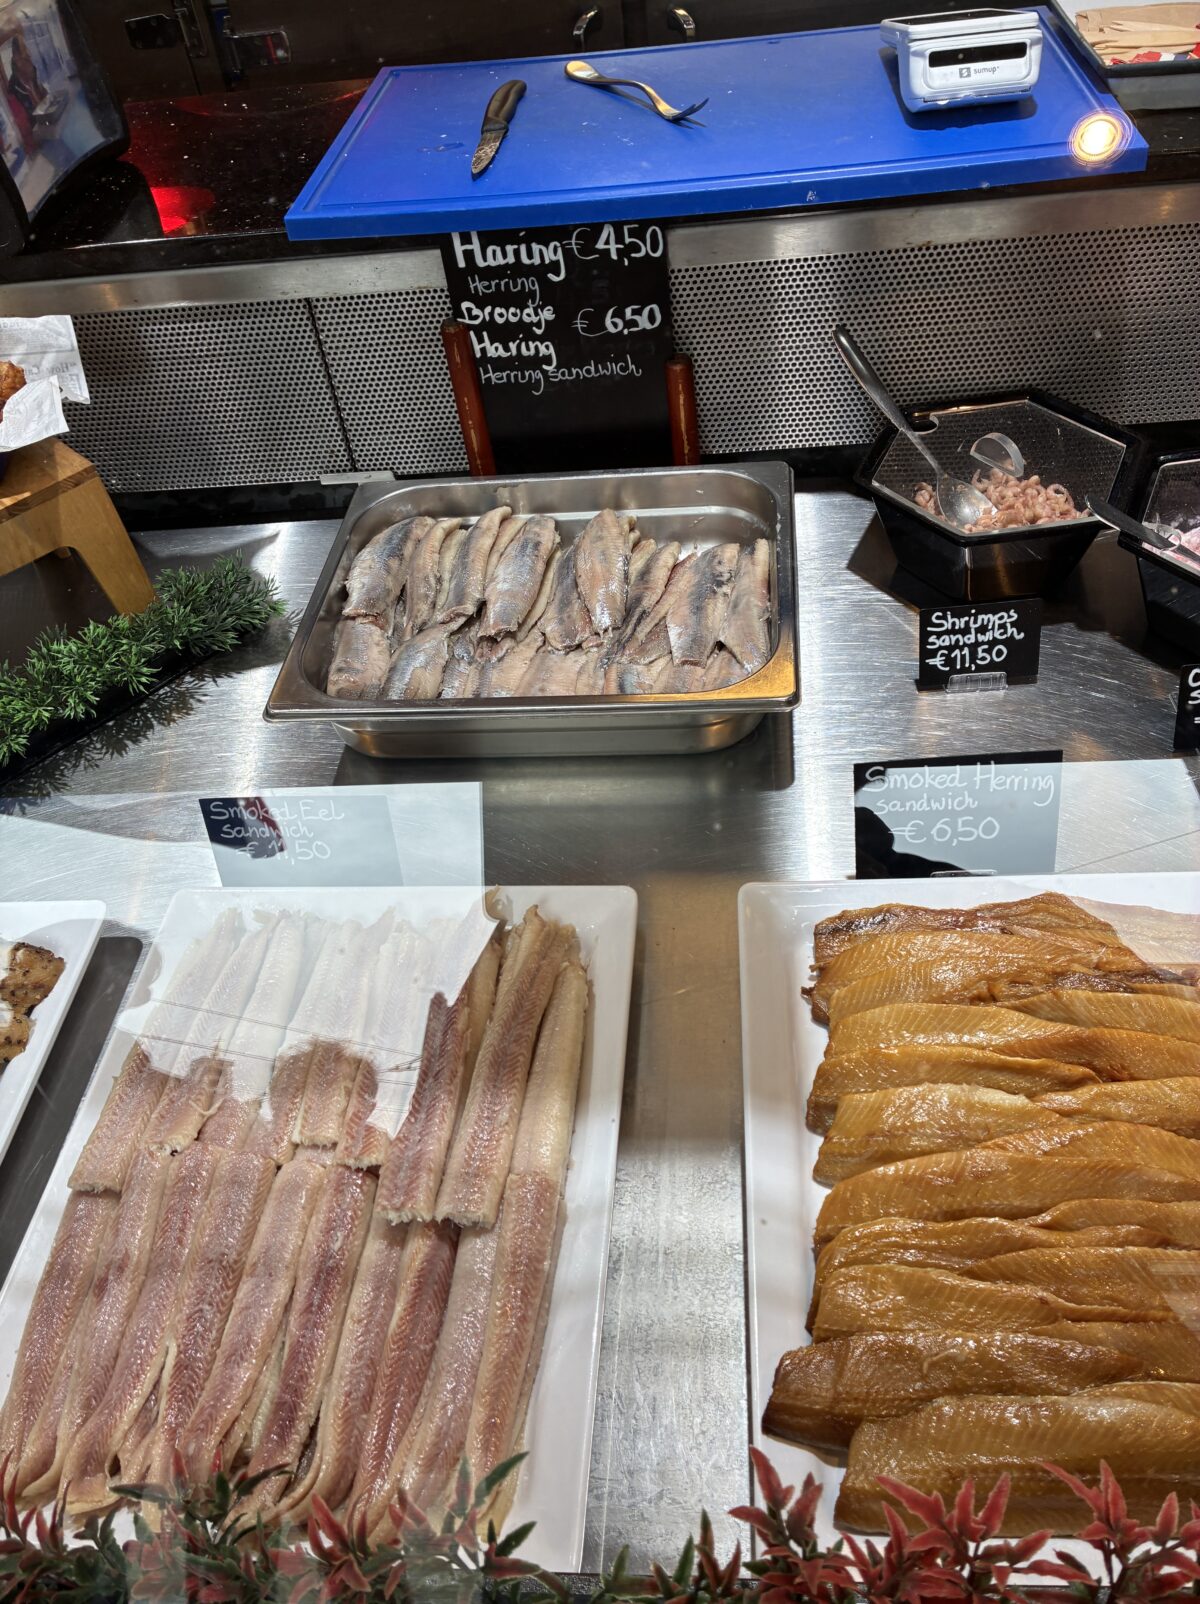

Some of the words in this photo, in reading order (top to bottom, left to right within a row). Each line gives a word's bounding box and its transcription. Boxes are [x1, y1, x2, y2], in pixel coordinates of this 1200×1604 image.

[451, 231, 566, 282] Haring
[468, 270, 540, 307] Herring
[457, 300, 556, 334] Broodje
[469, 333, 557, 370] Haring
[480, 361, 544, 395] Herring
[549, 353, 642, 381] sandwich
[926, 609, 1018, 636] Shrimps
[926, 622, 1025, 649] sandwich
[925, 644, 1008, 671] €11,50
[862, 765, 967, 792] Smoked
[974, 761, 1055, 807] Herring
[209, 801, 297, 820] Smoked
[300, 799, 345, 821] Eel
[874, 790, 978, 815] sandwich
[220, 821, 314, 840] sandwich
